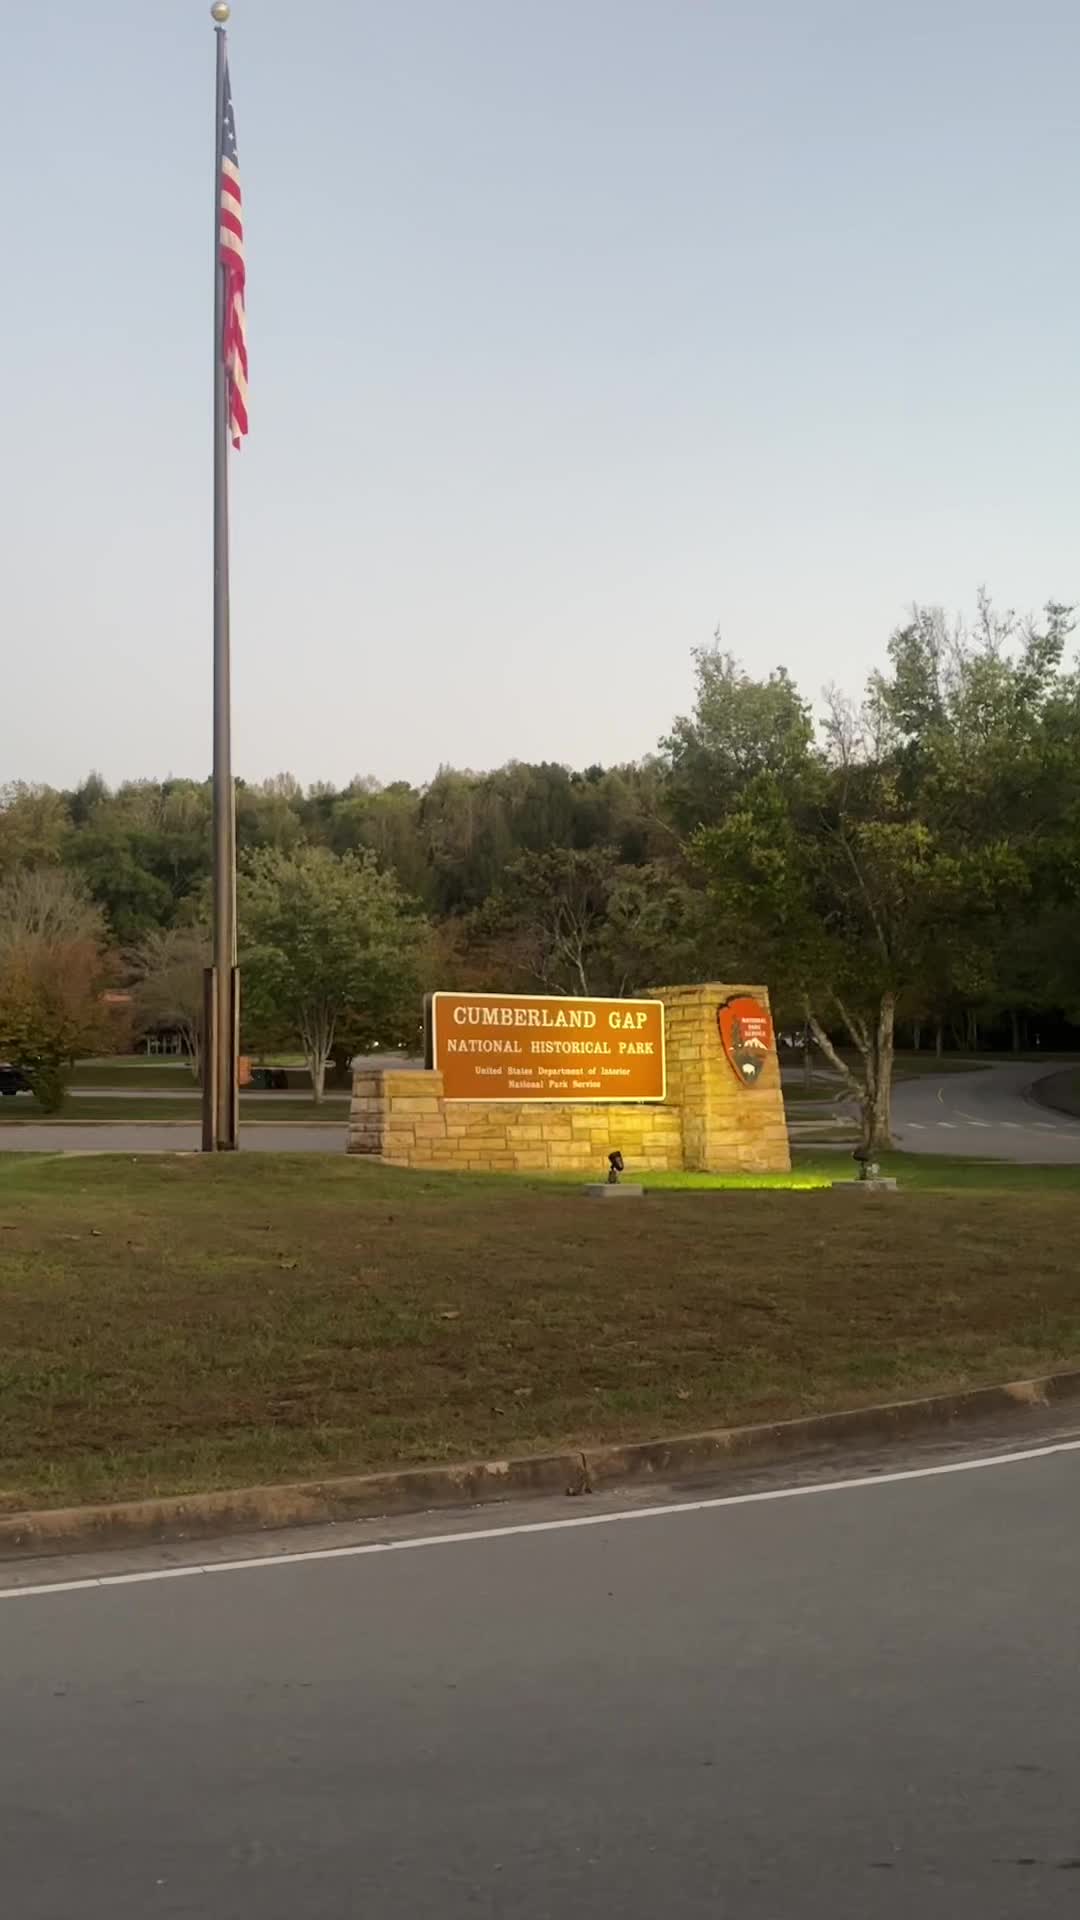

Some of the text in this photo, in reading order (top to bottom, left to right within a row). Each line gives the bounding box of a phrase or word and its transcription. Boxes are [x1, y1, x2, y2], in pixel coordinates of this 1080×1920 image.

[453, 1006, 648, 1030] CUMBERLAND GAP
[447, 1039, 655, 1055] NATIONAL HISTORICAL PARK
[475, 1066, 631, 1077] United States Department of Interior
[508, 1079, 601, 1089] National Park Service
